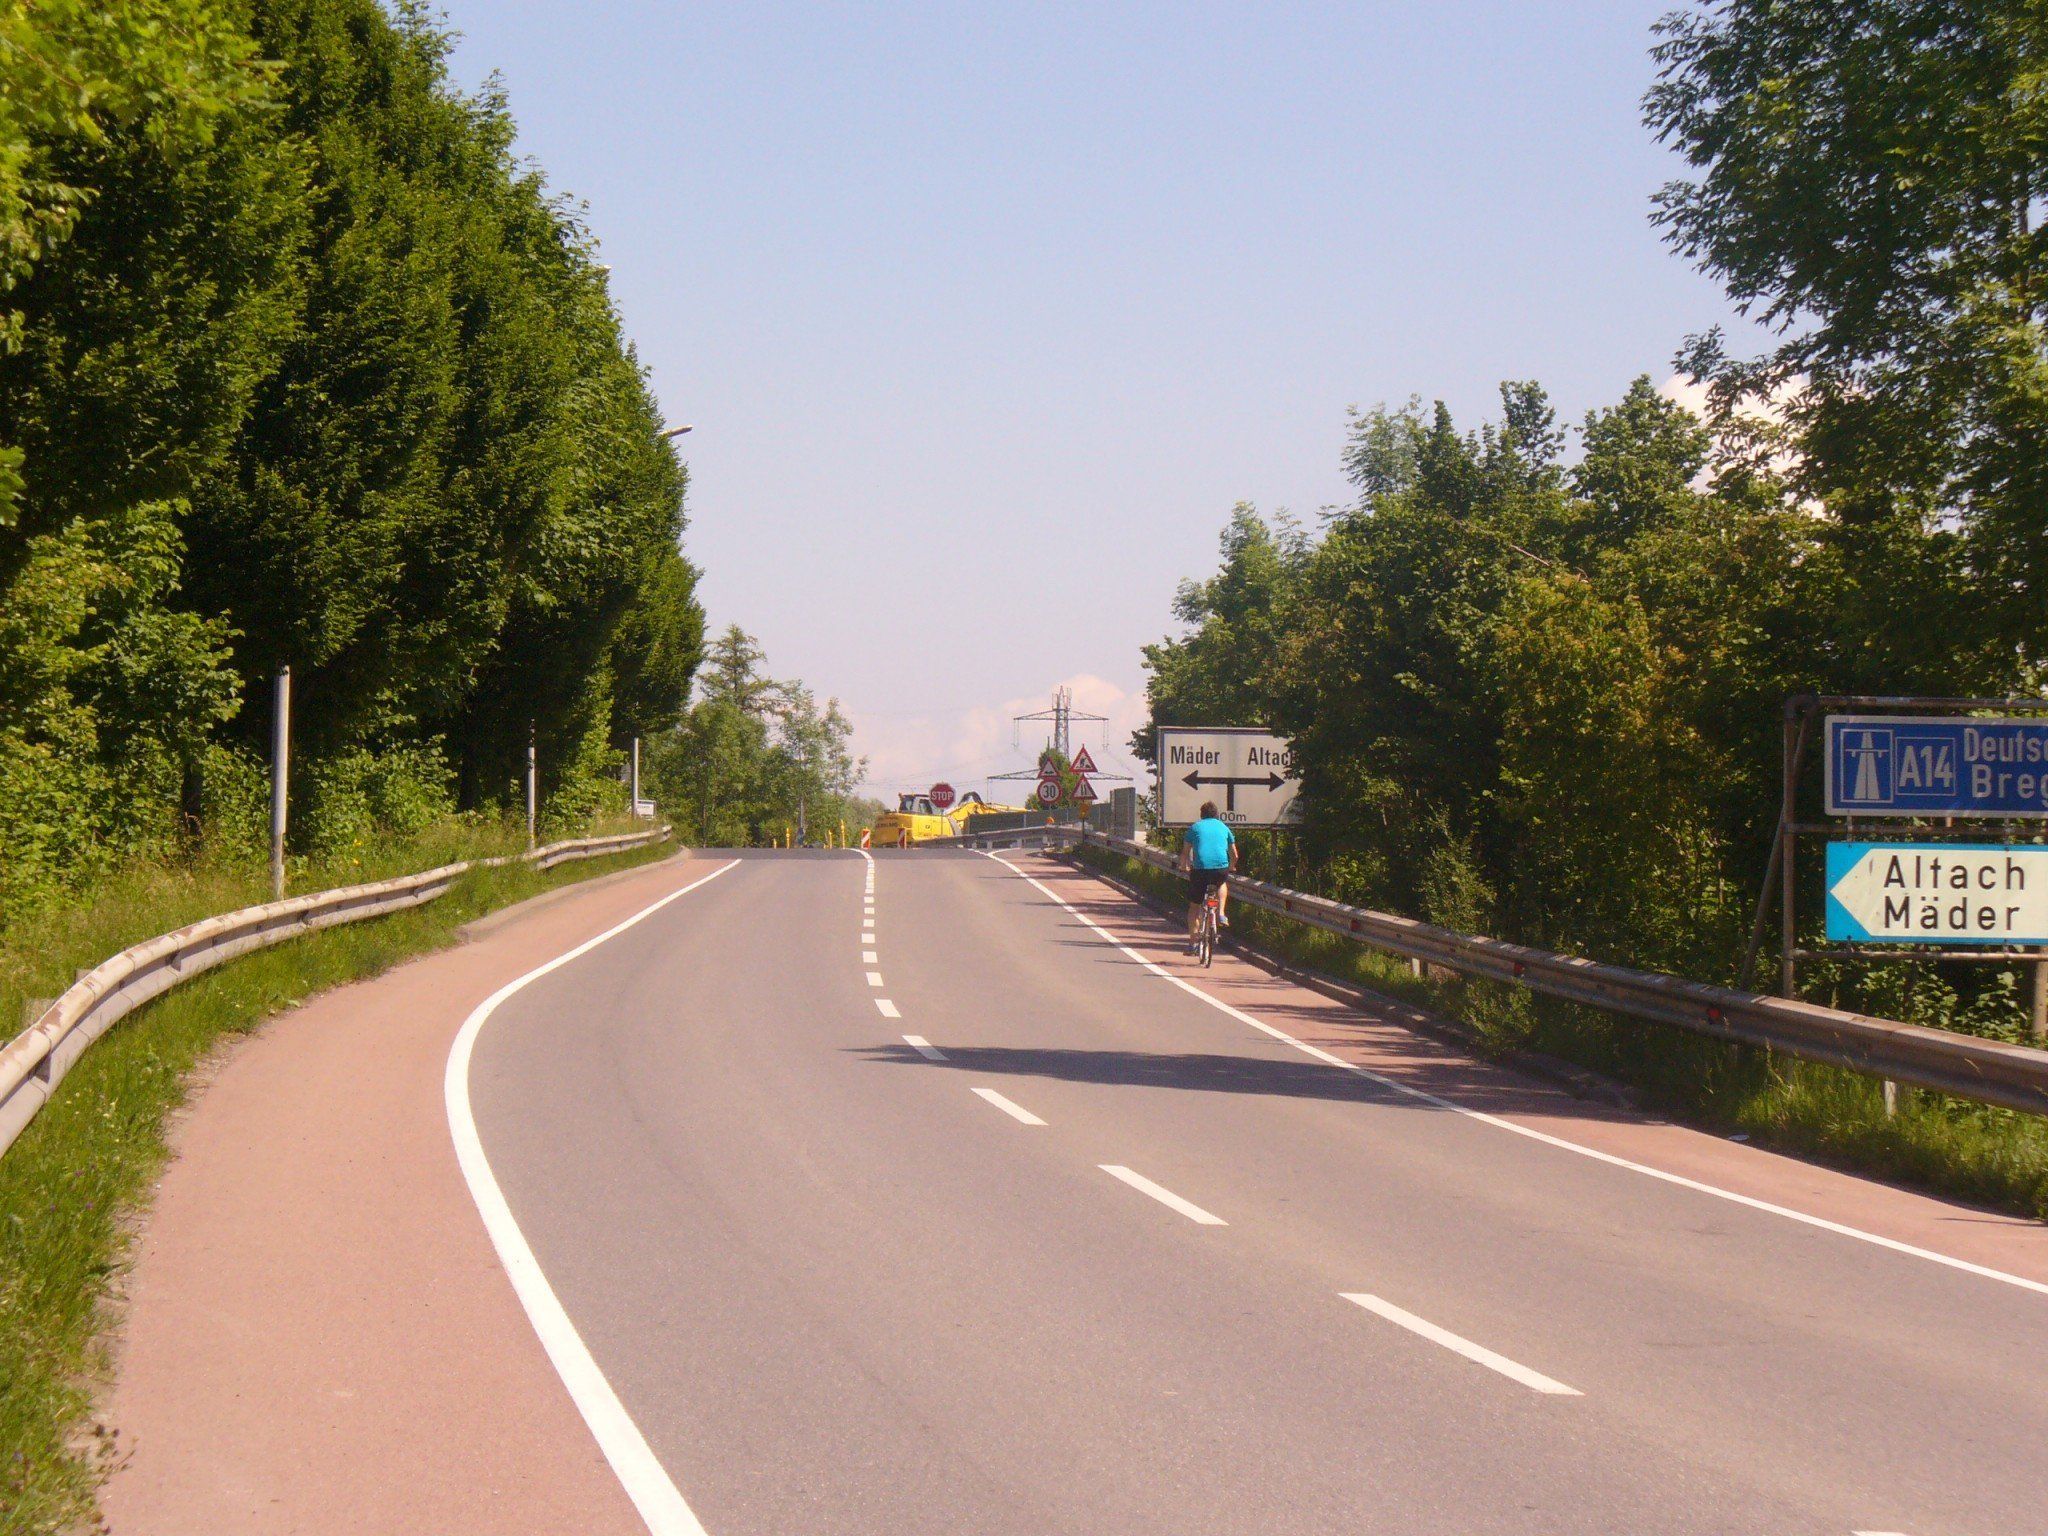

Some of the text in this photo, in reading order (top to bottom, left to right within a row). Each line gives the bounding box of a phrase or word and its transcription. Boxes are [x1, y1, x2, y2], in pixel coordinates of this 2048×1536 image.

[1170, 745, 1220, 765] Mäder
[1898, 745, 1954, 788] A14
[931, 791, 953, 801] STOP
[1043, 785, 1055, 799] 30
[1883, 855, 2025, 890] Altach
[1883, 895, 2020, 930] Mäder
